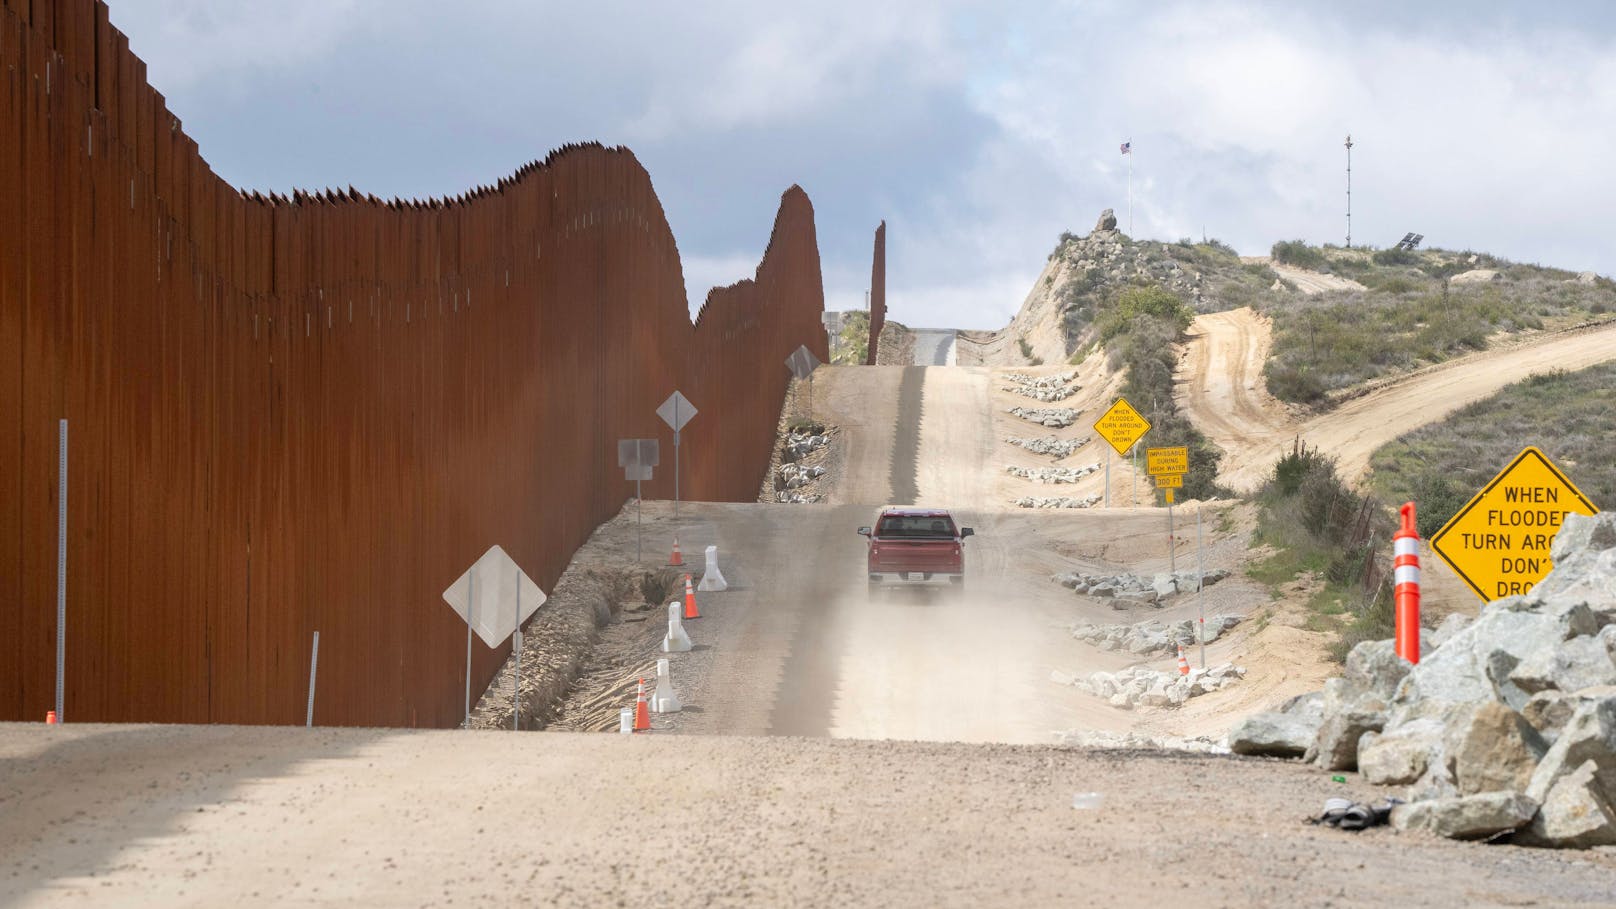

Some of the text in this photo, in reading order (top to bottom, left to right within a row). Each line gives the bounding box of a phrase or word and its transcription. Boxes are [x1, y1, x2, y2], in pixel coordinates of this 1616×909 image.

[1173, 477, 1180, 485] FT
[1505, 487, 1558, 503] WHEN
[1461, 533, 1511, 550] TURN
[1502, 557, 1551, 574] DON'
